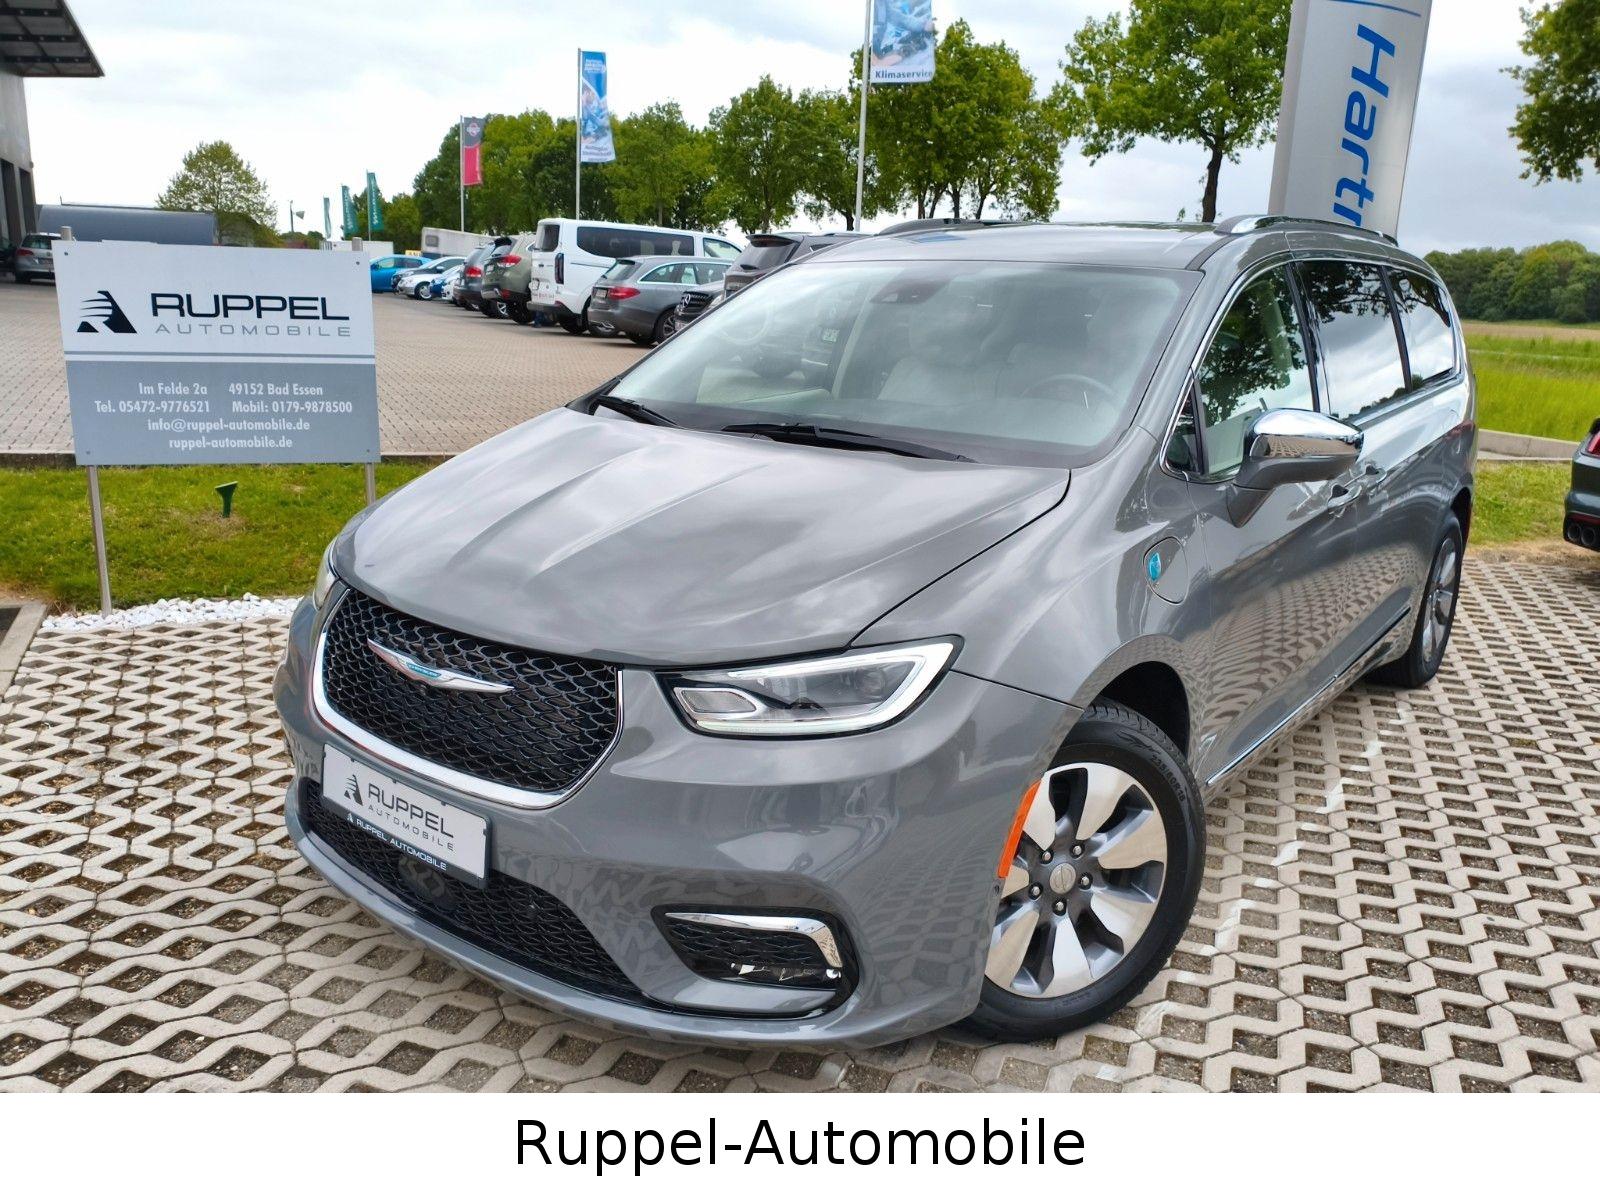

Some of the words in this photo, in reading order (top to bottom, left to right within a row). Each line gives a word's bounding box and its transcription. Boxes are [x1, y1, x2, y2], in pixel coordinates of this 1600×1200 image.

[151, 292, 350, 321] RUPPEL
[155, 323, 351, 337] AUTOMOBILE
[138, 382, 155, 395] Im
[157, 382, 190, 395] Felde
[192, 383, 208, 395] 2a
[228, 383, 264, 395] 49152
[267, 382, 290, 395] Bad
[292, 383, 324, 396] Essen
[94, 400, 116, 413] Tel.
[119, 400, 210, 413] 05472-9776521
[232, 400, 269, 413] Mobil:
[272, 400, 353, 413] 0179-9878500
[147, 418, 311, 433] info@ruppel-automobile.de
[168, 436, 293, 451] ruppel-automobile.de
[367, 782, 454, 839] RUPPEL
[367, 804, 454, 852] AUTOMOBILE
[356, 818, 388, 842] RUPPEL
[389, 838, 448, 872] AUTOMOBILE
